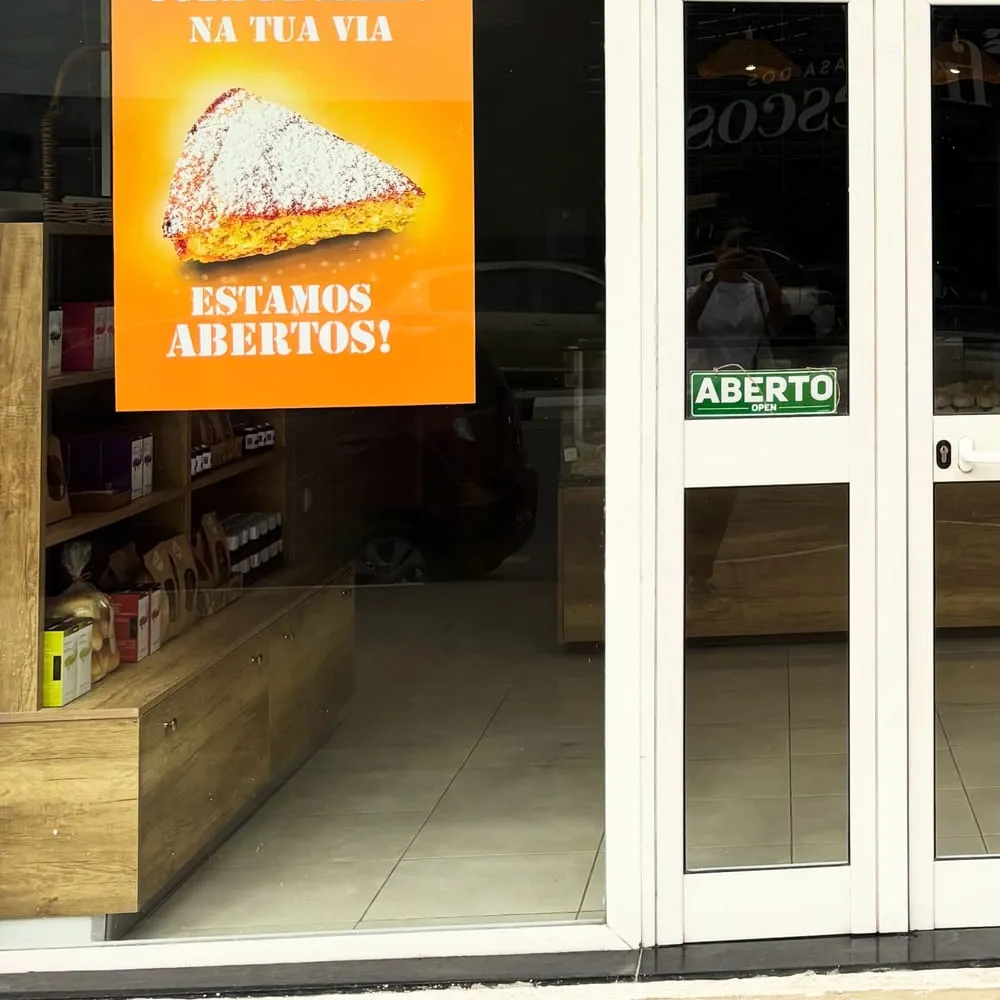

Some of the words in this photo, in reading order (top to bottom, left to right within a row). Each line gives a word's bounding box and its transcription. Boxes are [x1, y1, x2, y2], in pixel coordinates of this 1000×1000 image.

[189, 16, 238, 42] NA
[249, 16, 320, 42] TUA
[332, 16, 393, 41] VIA
[191, 283, 373, 317] ESTAMOS
[166, 319, 391, 358] ABERTOS!
[695, 374, 833, 404] ABERTO
[751, 403, 777, 412] OPEN
